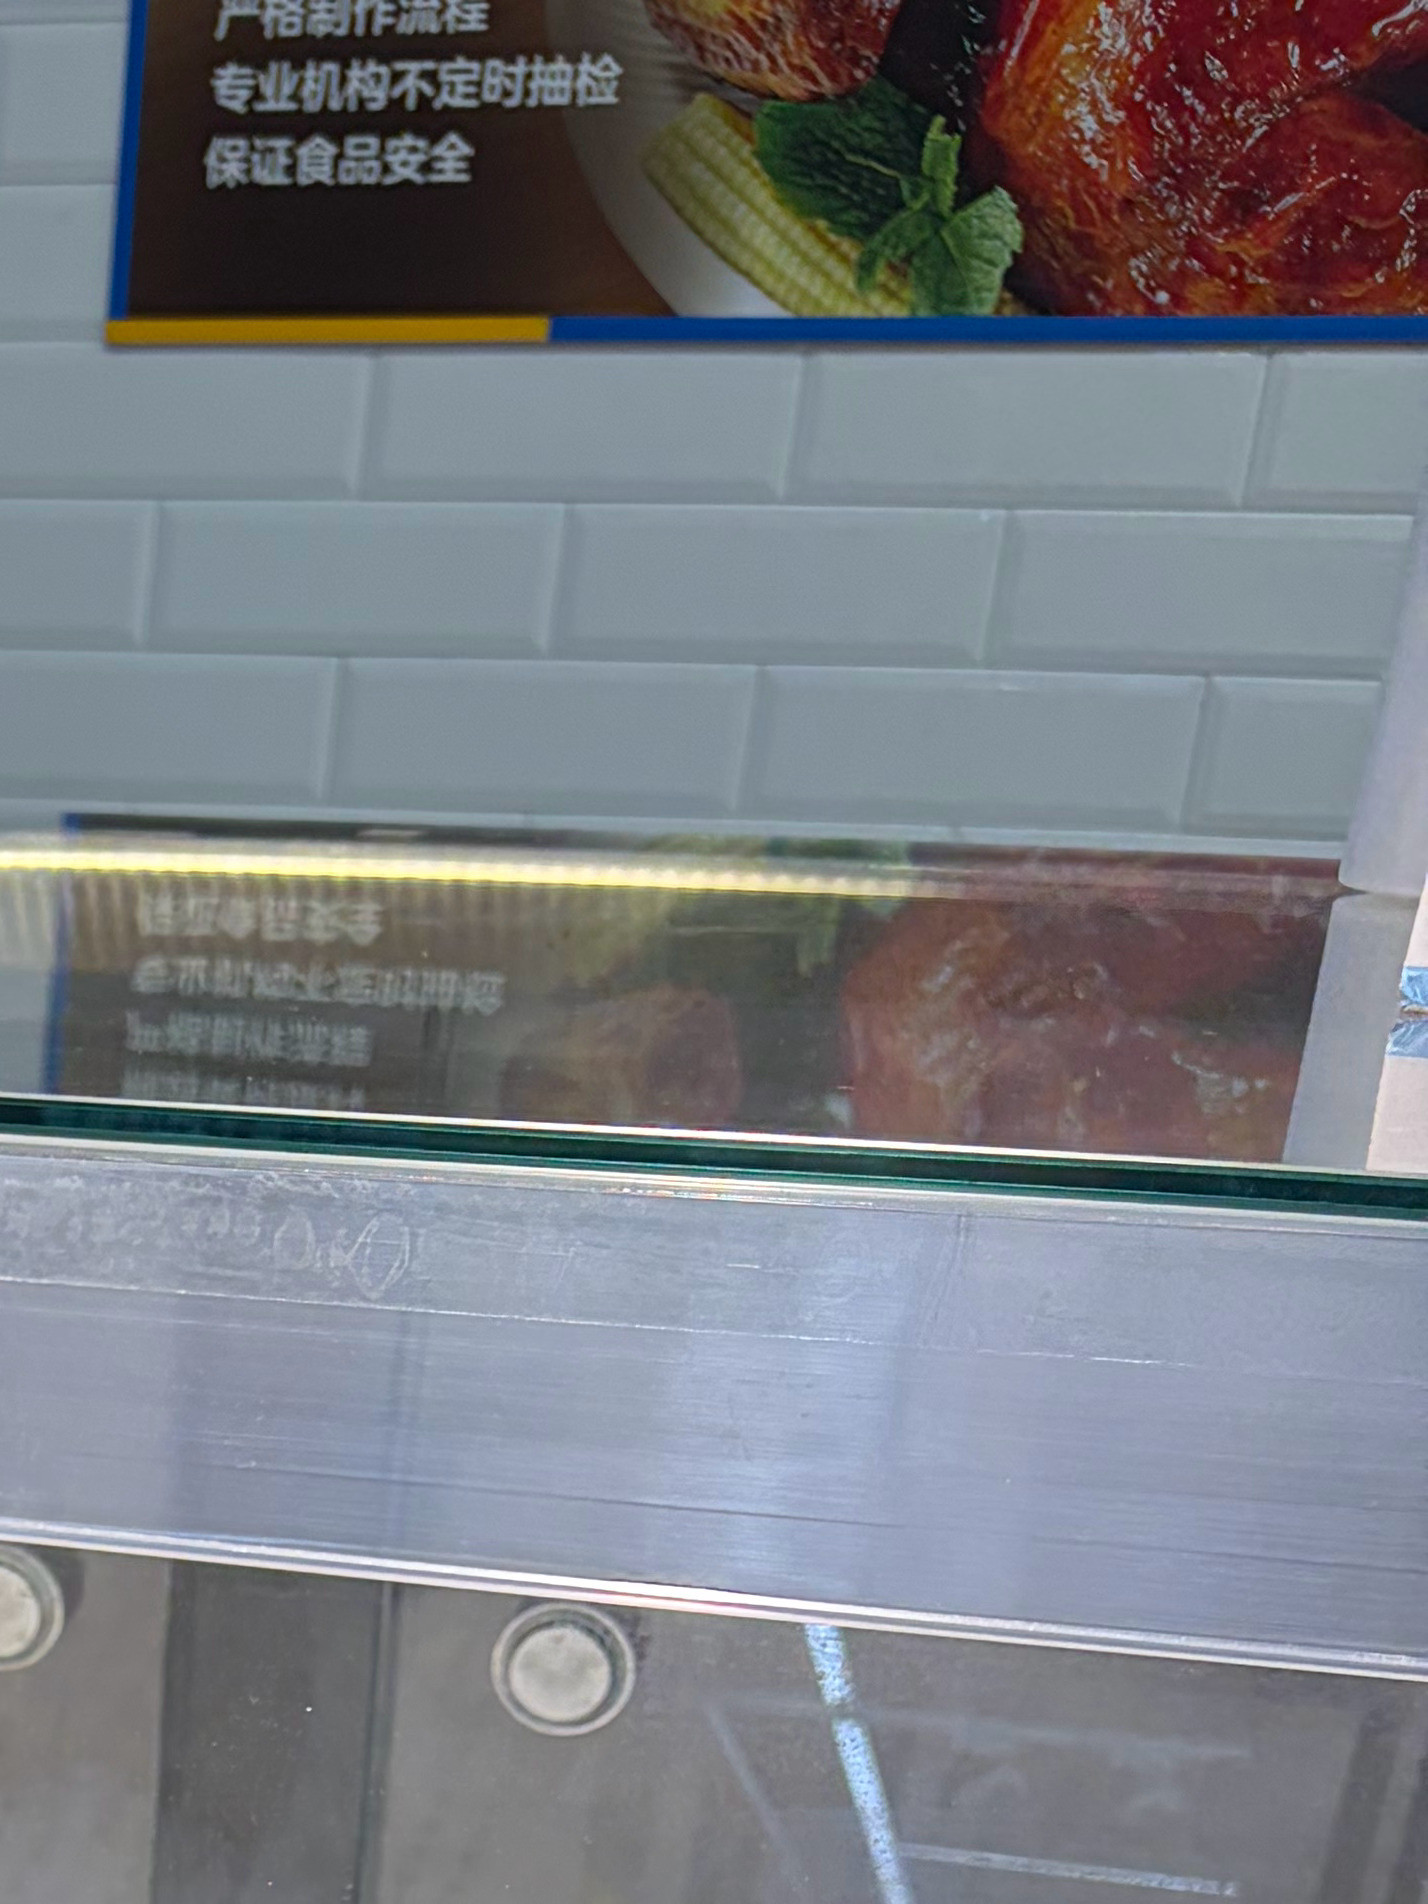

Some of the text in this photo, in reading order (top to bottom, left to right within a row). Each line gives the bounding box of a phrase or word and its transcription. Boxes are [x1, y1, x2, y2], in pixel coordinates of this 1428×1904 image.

[211, 51, 622, 114] 专业机构不定时抽检
[205, 132, 475, 189] 保证食品安全
